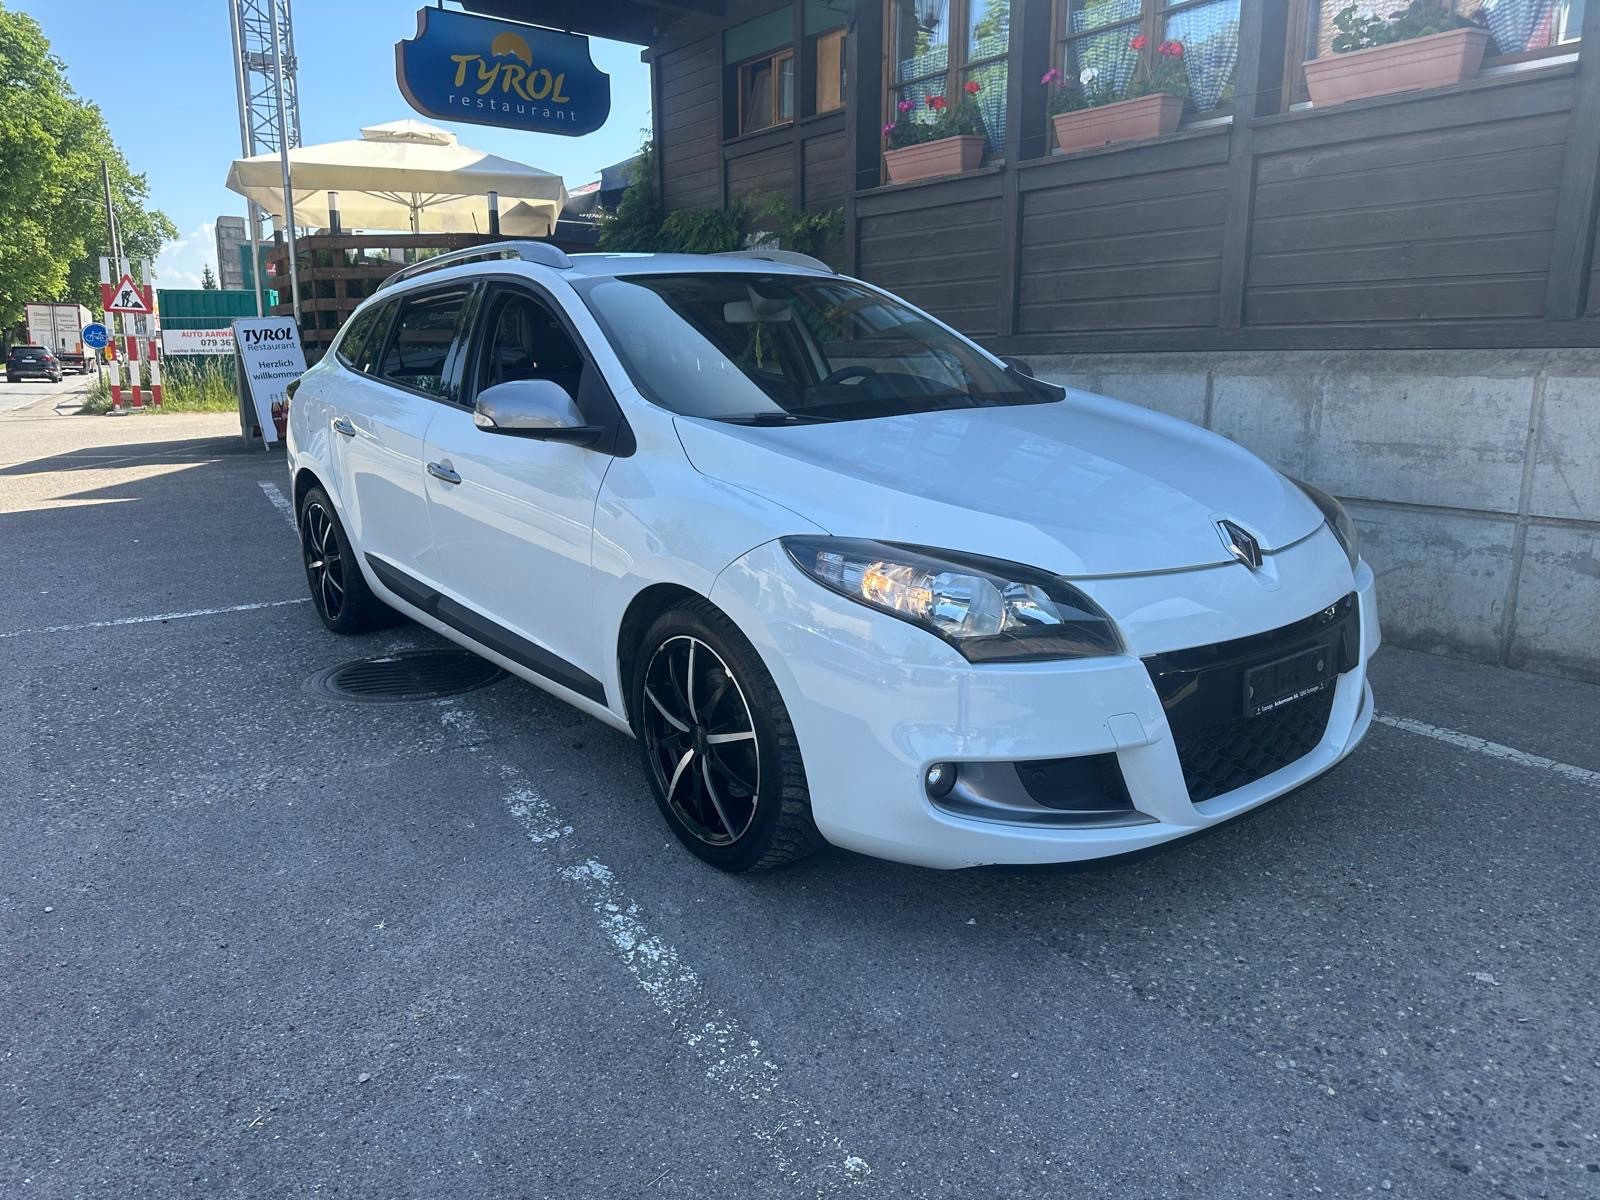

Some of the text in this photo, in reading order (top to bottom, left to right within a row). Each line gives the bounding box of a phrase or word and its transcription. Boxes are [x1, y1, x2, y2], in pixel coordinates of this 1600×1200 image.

[451, 54, 570, 104] TYROL
[449, 94, 576, 121] restaurant
[243, 327, 293, 345] TYROL
[247, 342, 296, 352] Restaurant
[258, 359, 294, 369] Herzlich
